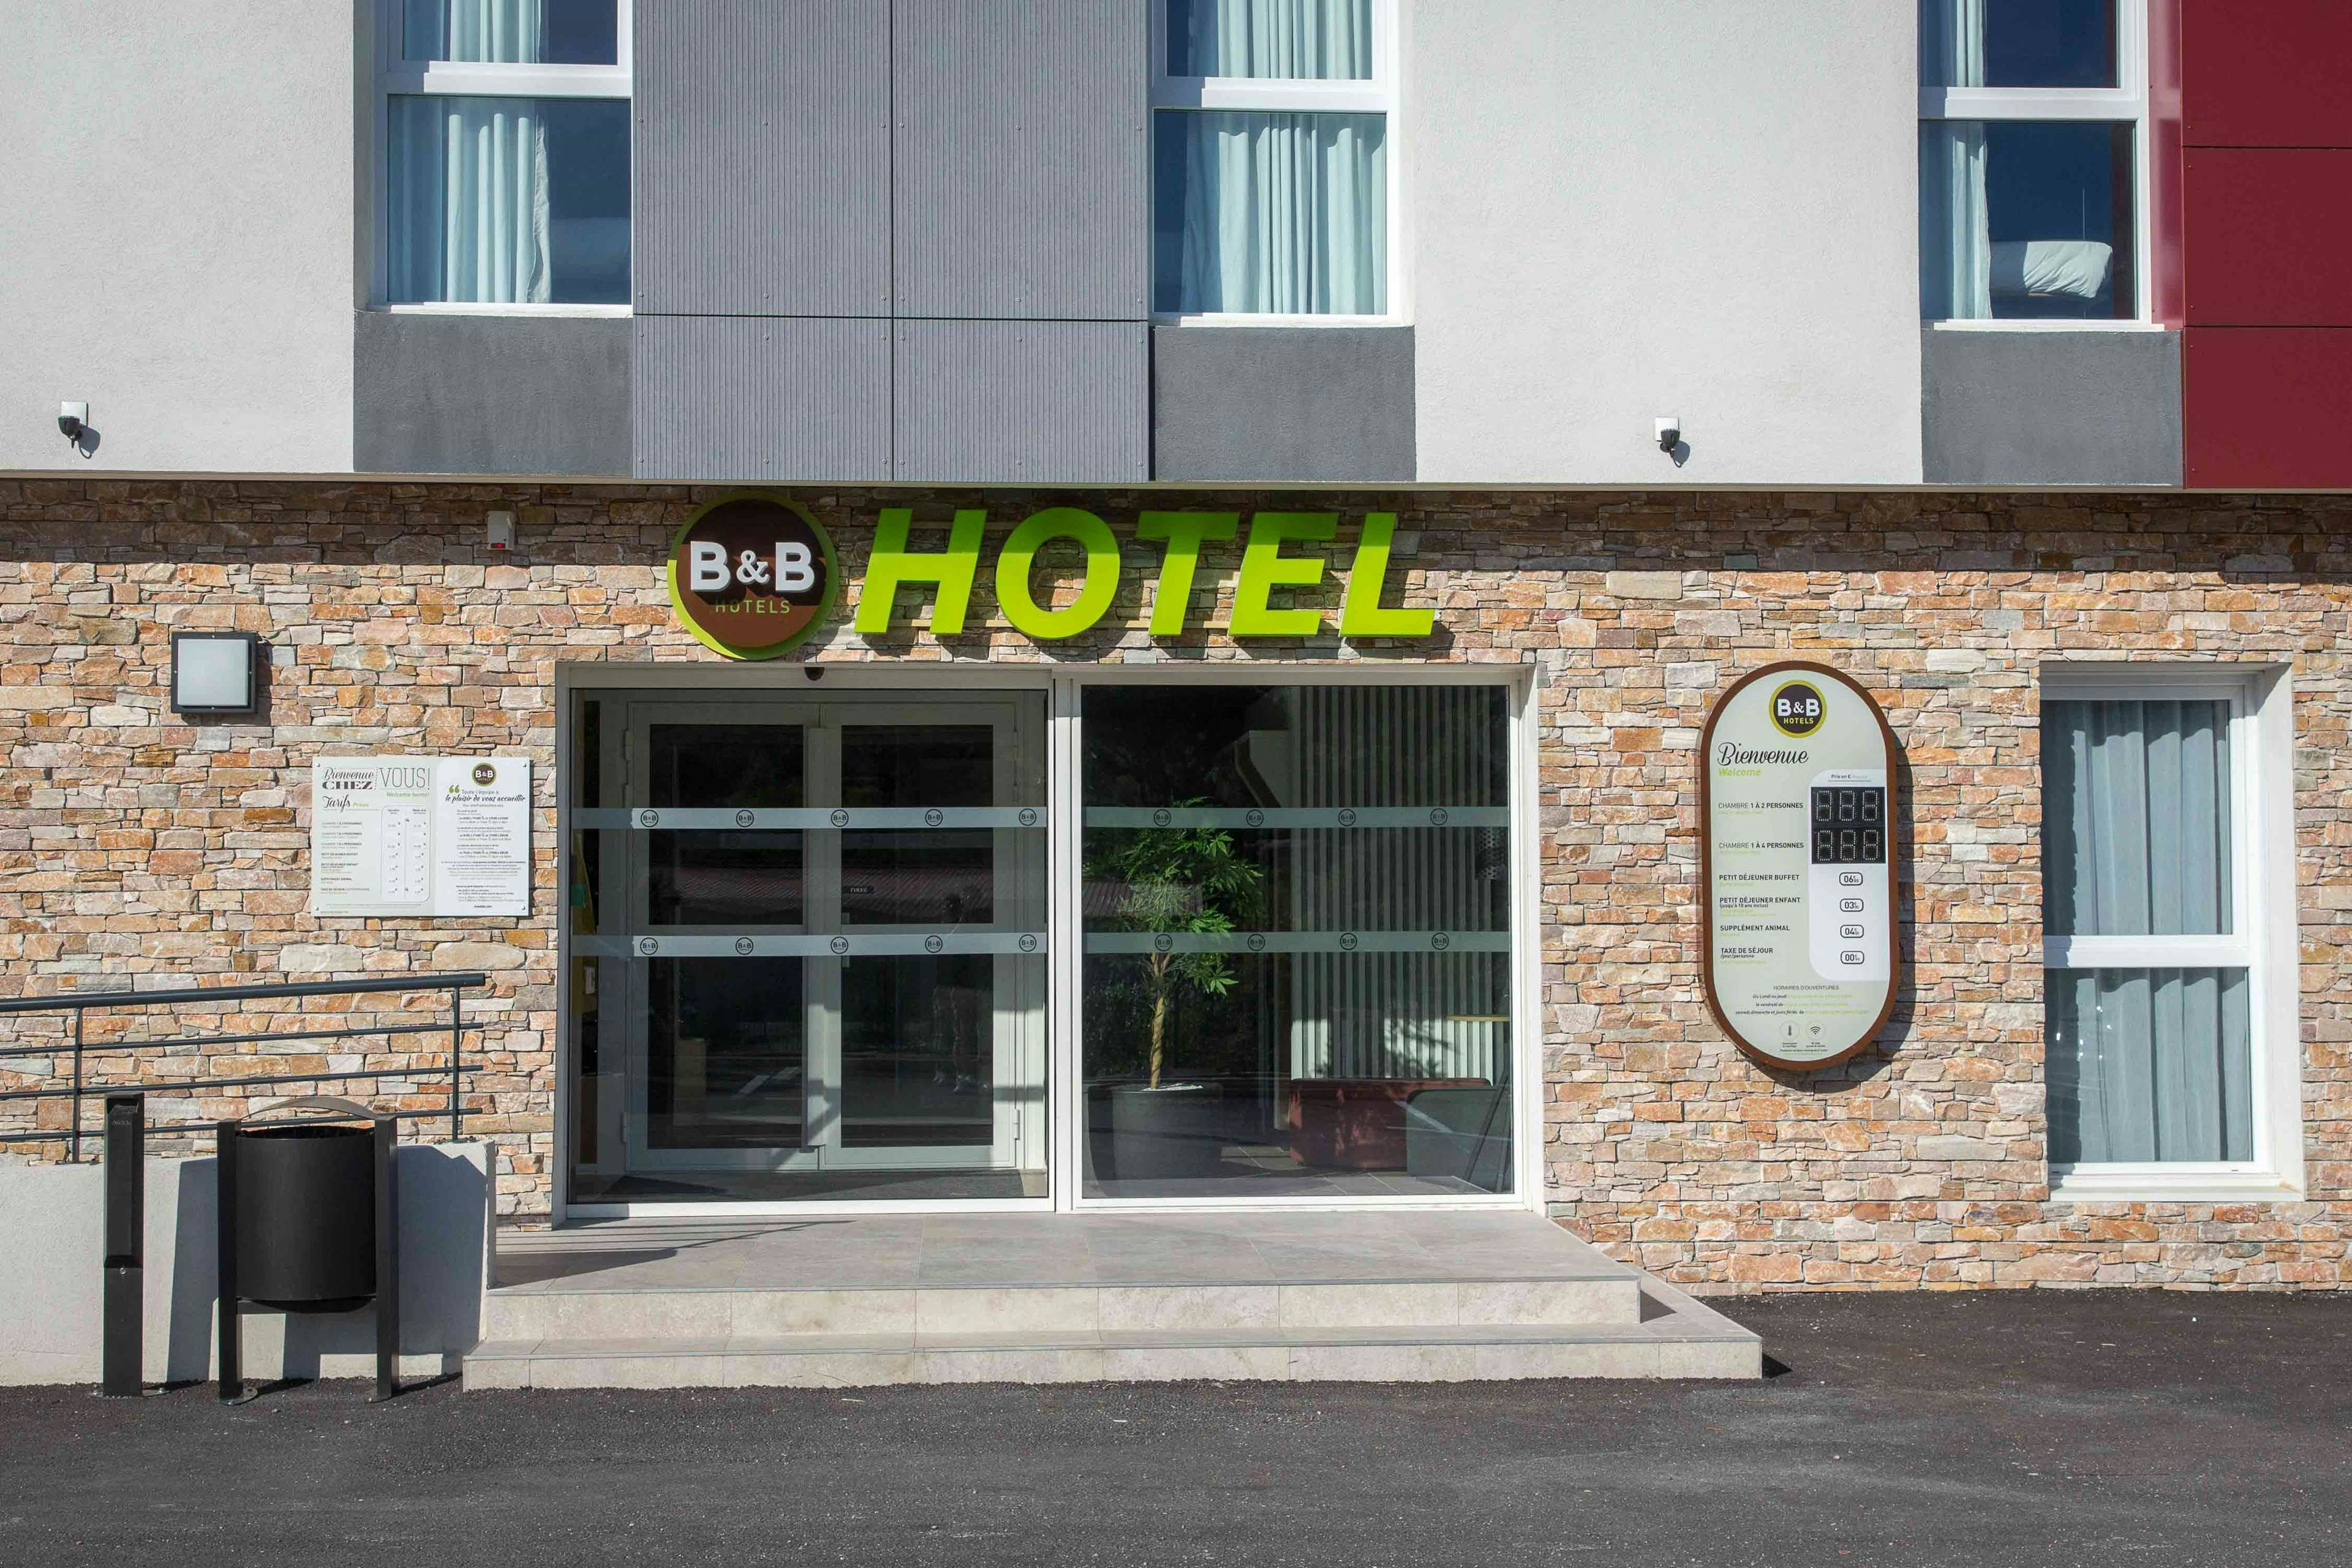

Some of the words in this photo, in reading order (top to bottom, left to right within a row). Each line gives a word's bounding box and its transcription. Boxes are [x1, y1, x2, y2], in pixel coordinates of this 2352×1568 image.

[690, 541, 815, 593] B&B
[854, 507, 1434, 639] HOTEL
[715, 599, 790, 614] HOTELS
[1777, 699, 1820, 716] B&B
[1717, 742, 1809, 766] Bienvenue
[322, 767, 374, 780] Bienvenue
[379, 767, 430, 790] VOUS!
[322, 781, 372, 790] CHEZ
[323, 794, 350, 812] Tarifs
[451, 794, 472, 803] plaisir
